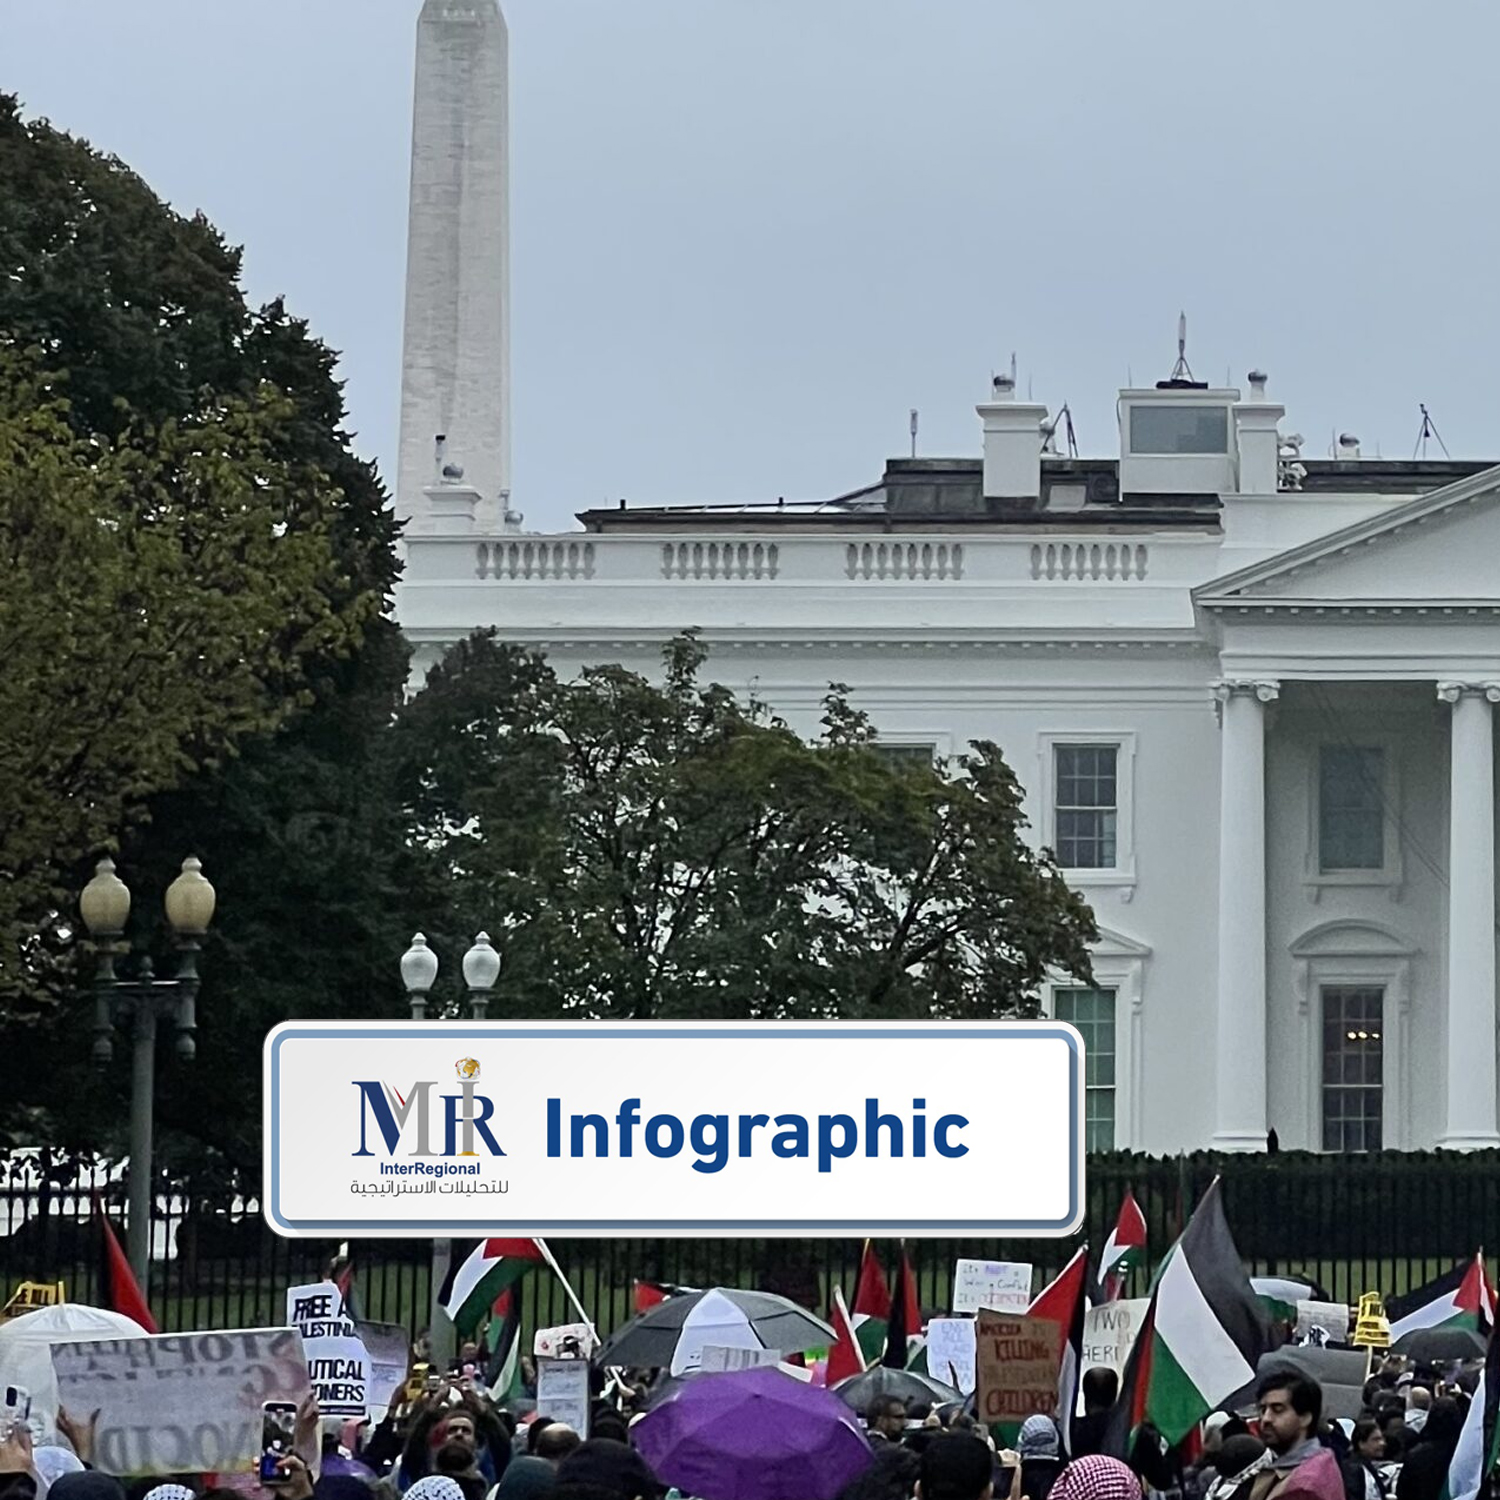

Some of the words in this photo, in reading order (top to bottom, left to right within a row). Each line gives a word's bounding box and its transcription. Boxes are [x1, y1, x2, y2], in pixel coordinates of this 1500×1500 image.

[293, 1295, 332, 1321] FREE
[1093, 1306, 1130, 1333] TWO
[995, 1338, 1050, 1363] KILLING
[987, 1389, 1059, 1416] CHILDREN
